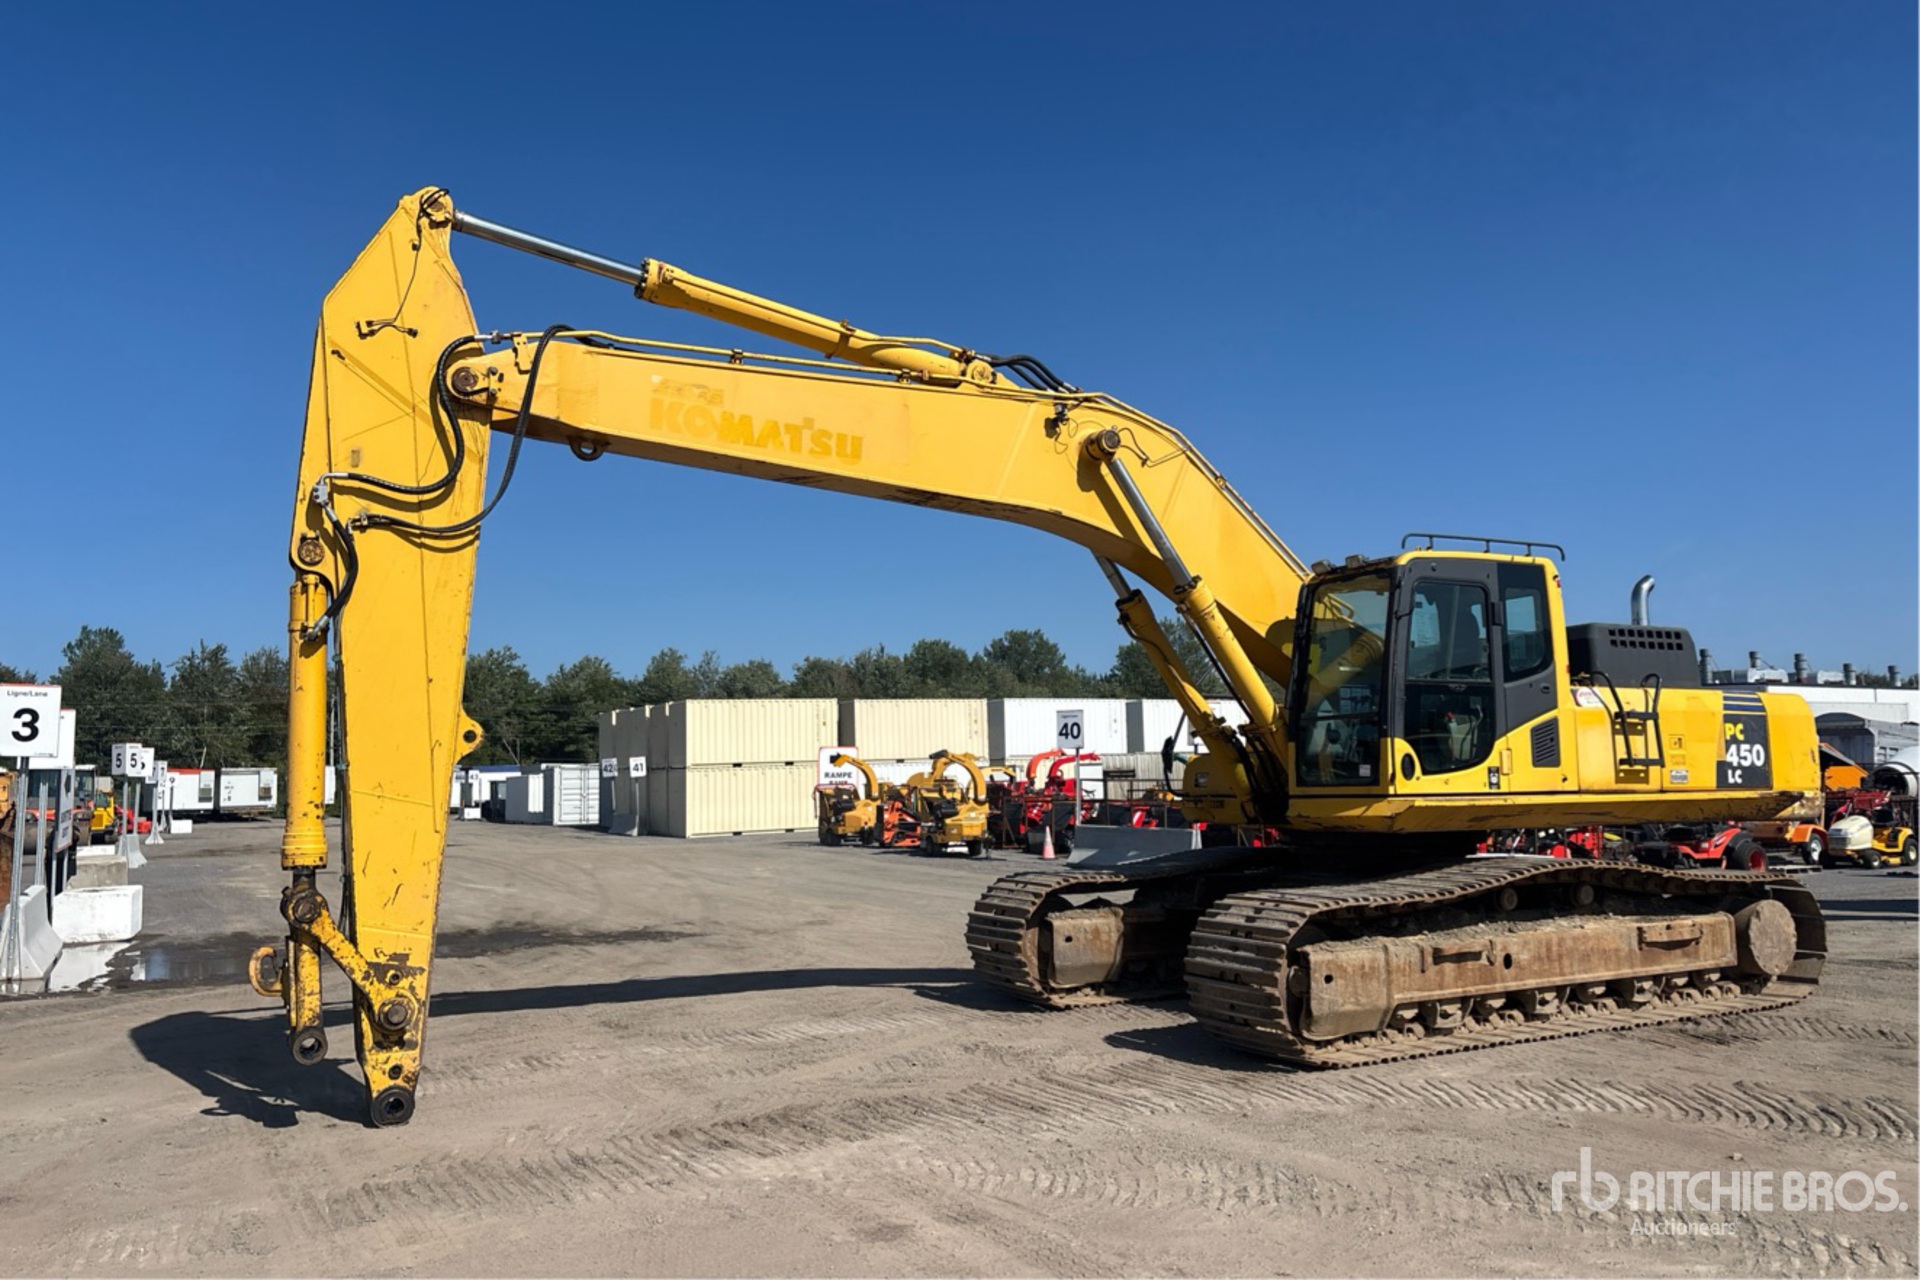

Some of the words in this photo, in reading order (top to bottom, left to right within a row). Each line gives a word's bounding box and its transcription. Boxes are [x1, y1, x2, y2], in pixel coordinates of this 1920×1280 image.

[649, 397, 864, 466] KOMATSU
[11, 707, 40, 742] 3
[1058, 721, 1081, 740] 40
[1724, 723, 1744, 740] PC
[130, 752, 138, 769] 5
[1726, 743, 1766, 767] 450
[603, 764, 614, 773] 42
[632, 763, 644, 772] 41
[1727, 769, 1743, 784] LC
